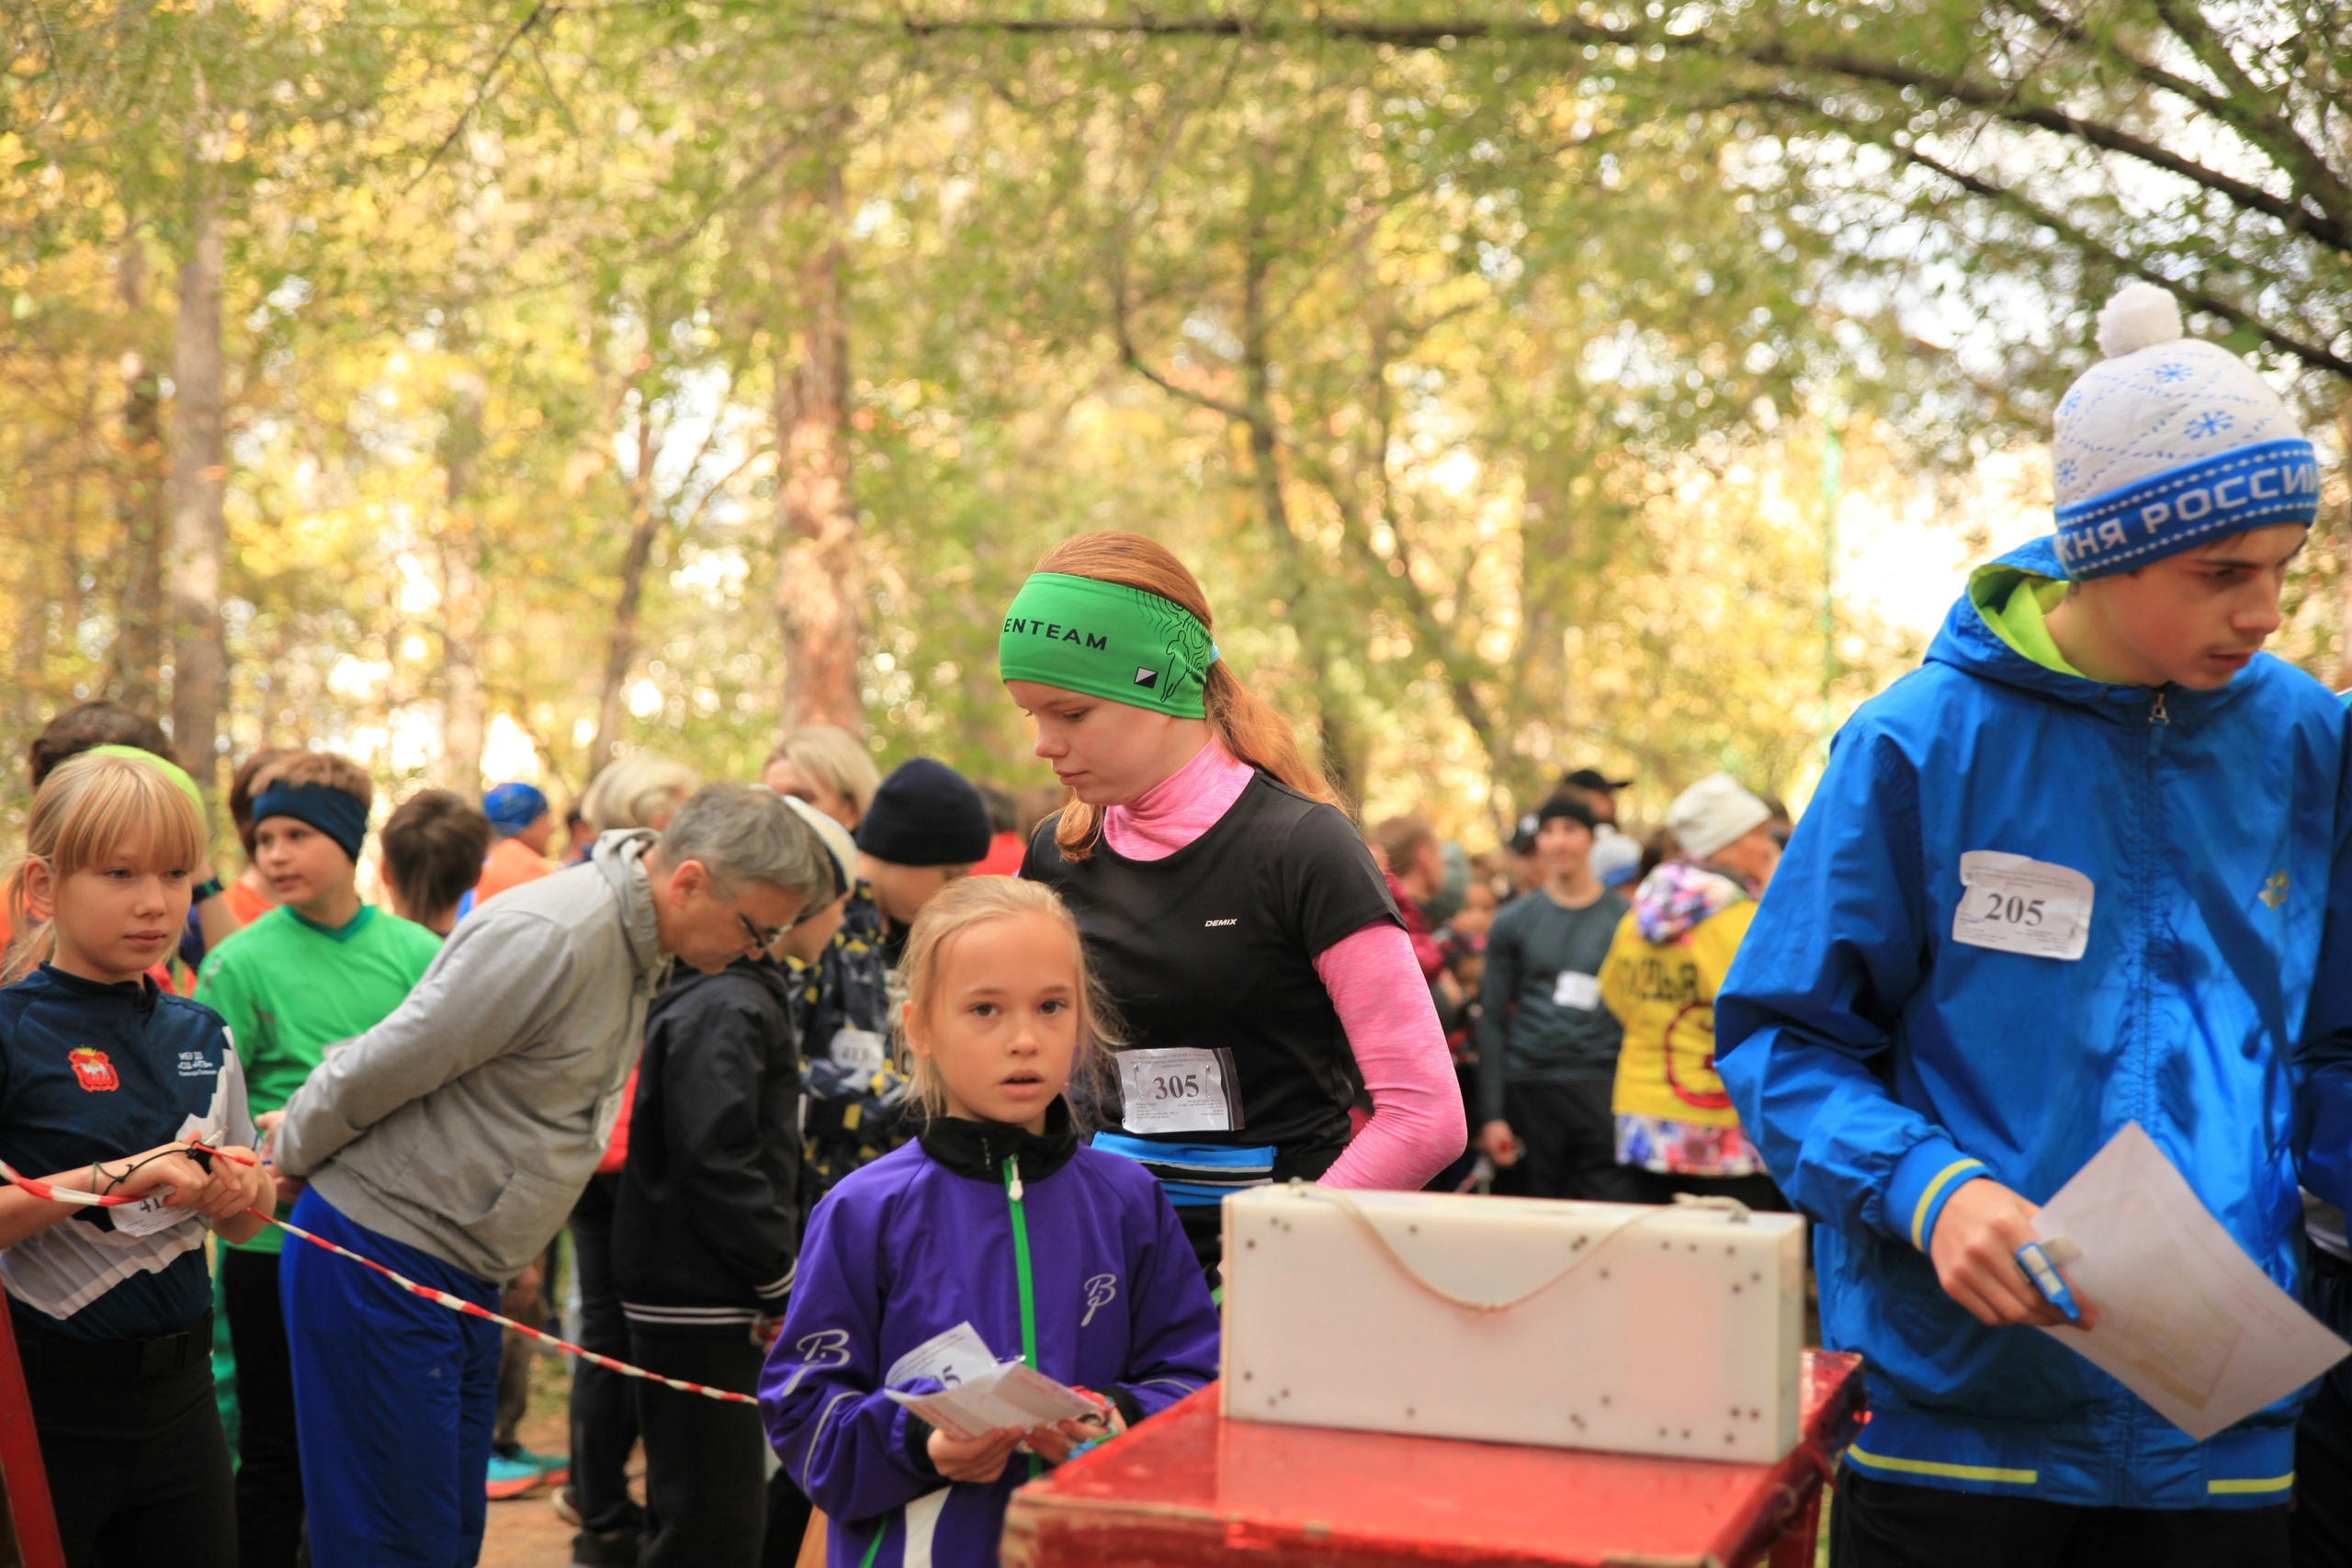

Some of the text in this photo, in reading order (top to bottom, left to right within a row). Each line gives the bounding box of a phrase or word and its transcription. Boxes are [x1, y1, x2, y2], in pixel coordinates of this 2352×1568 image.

[1002, 618, 1107, 651] ENTEAM
[1204, 919, 1238, 927] DEMIX
[1985, 893, 2045, 926] 205
[1153, 1075, 1200, 1100] 305
